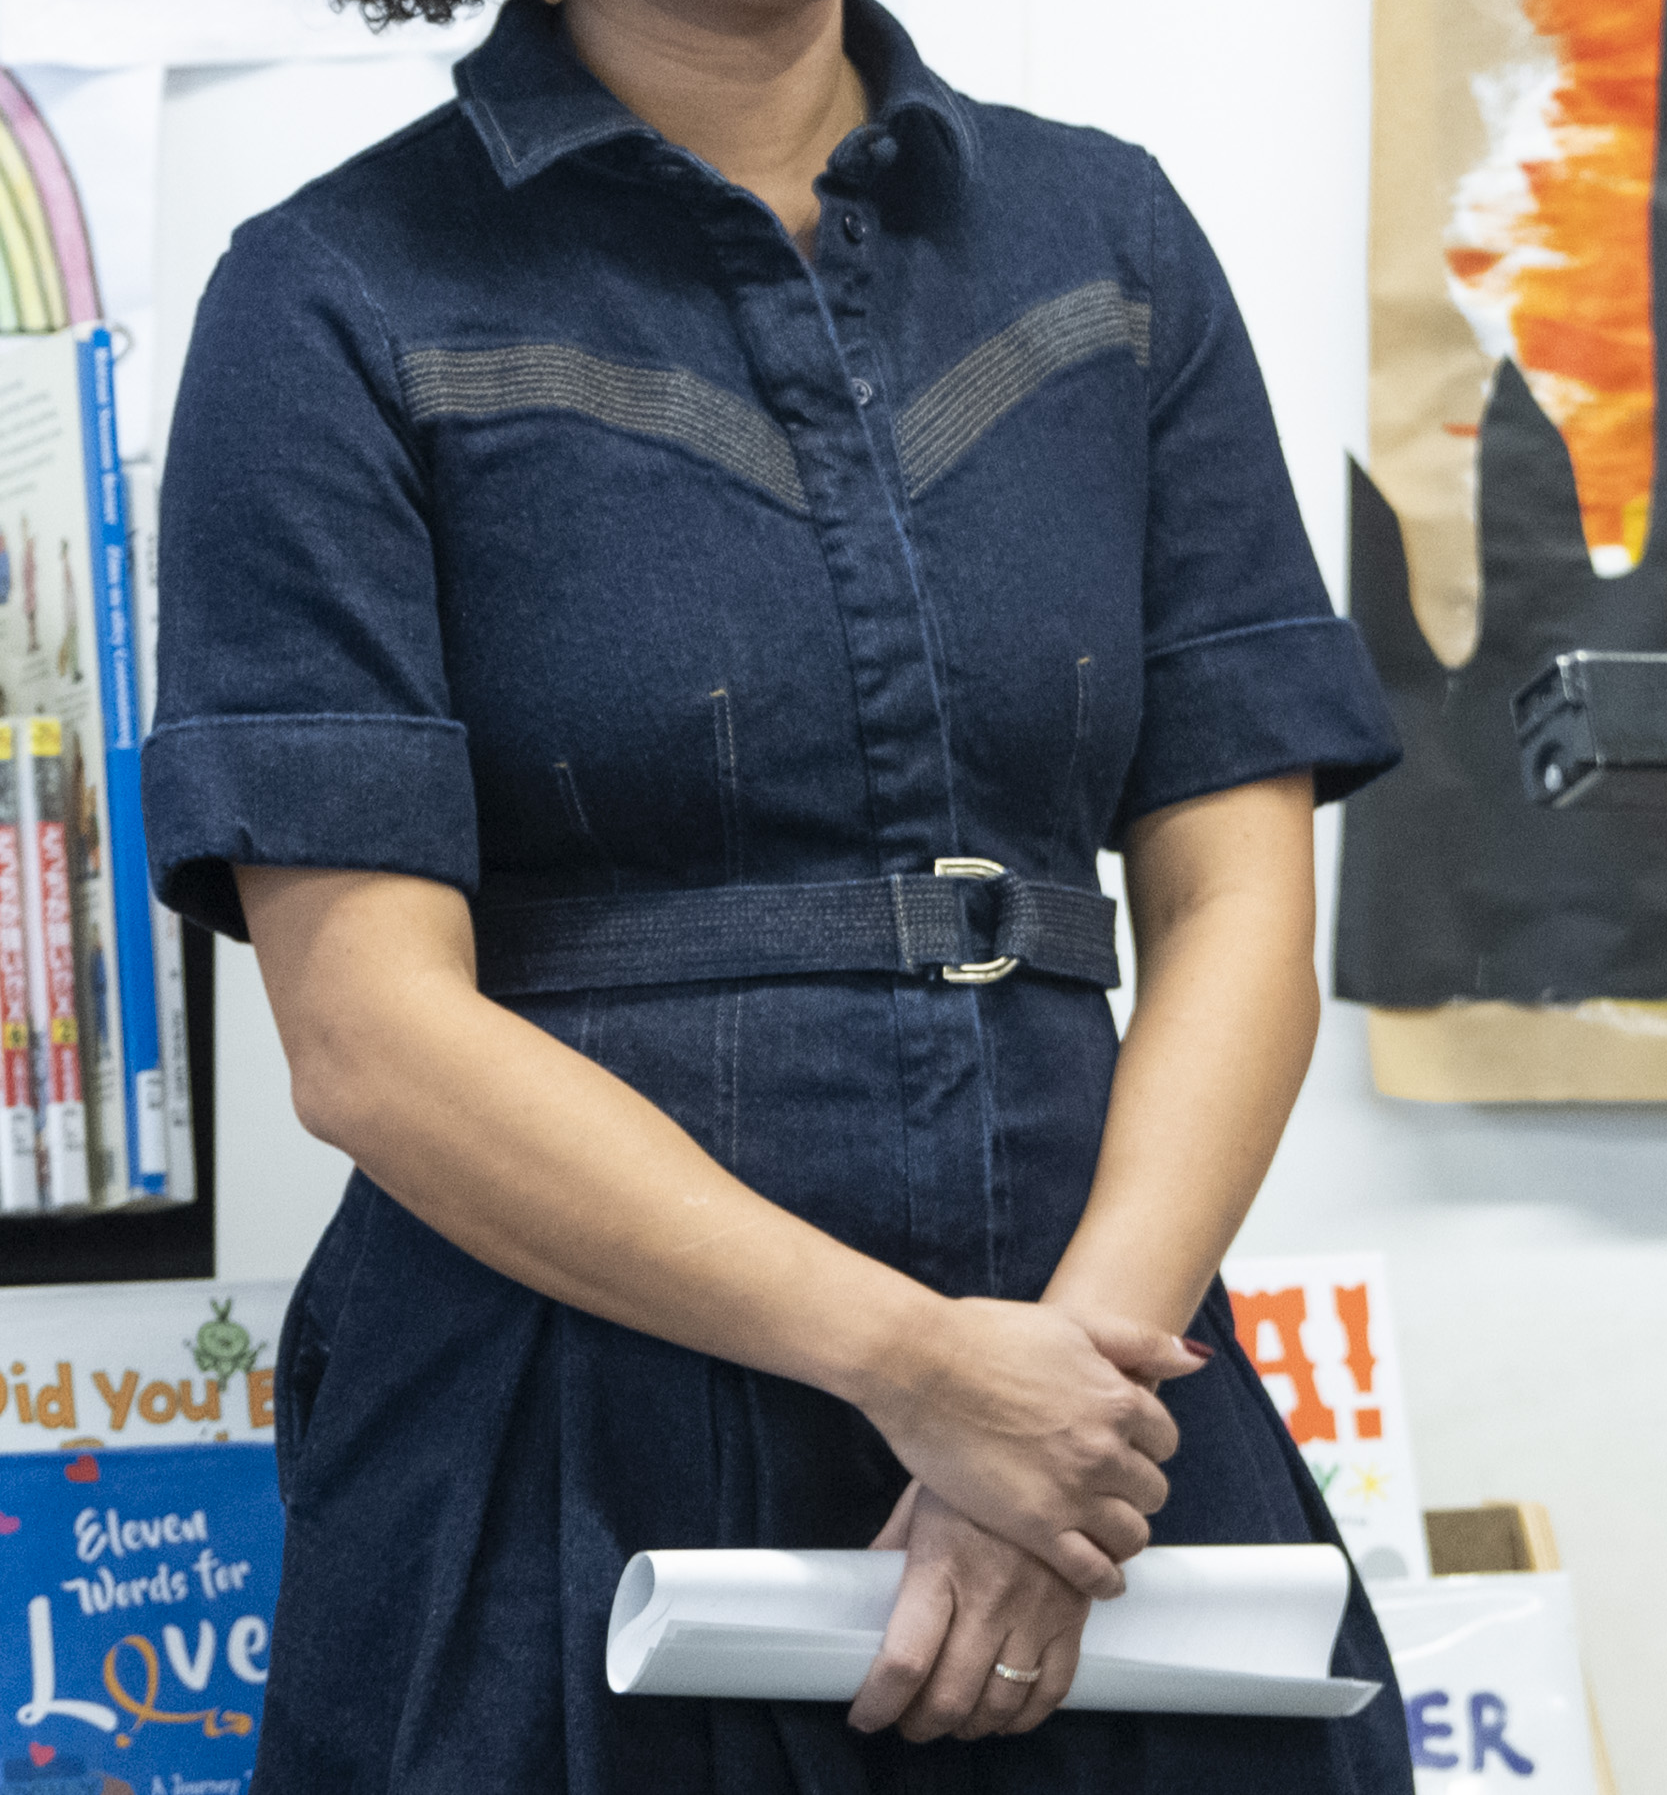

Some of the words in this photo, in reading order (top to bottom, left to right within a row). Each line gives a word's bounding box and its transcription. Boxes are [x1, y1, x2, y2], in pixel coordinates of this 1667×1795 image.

[0, 1362, 76, 1430] id
[92, 1370, 221, 1432] You
[74, 1507, 208, 1563] Eleven
[60, 1565, 190, 1615] Words
[192, 1548, 250, 1601] for
[16, 1594, 269, 1734] Love
